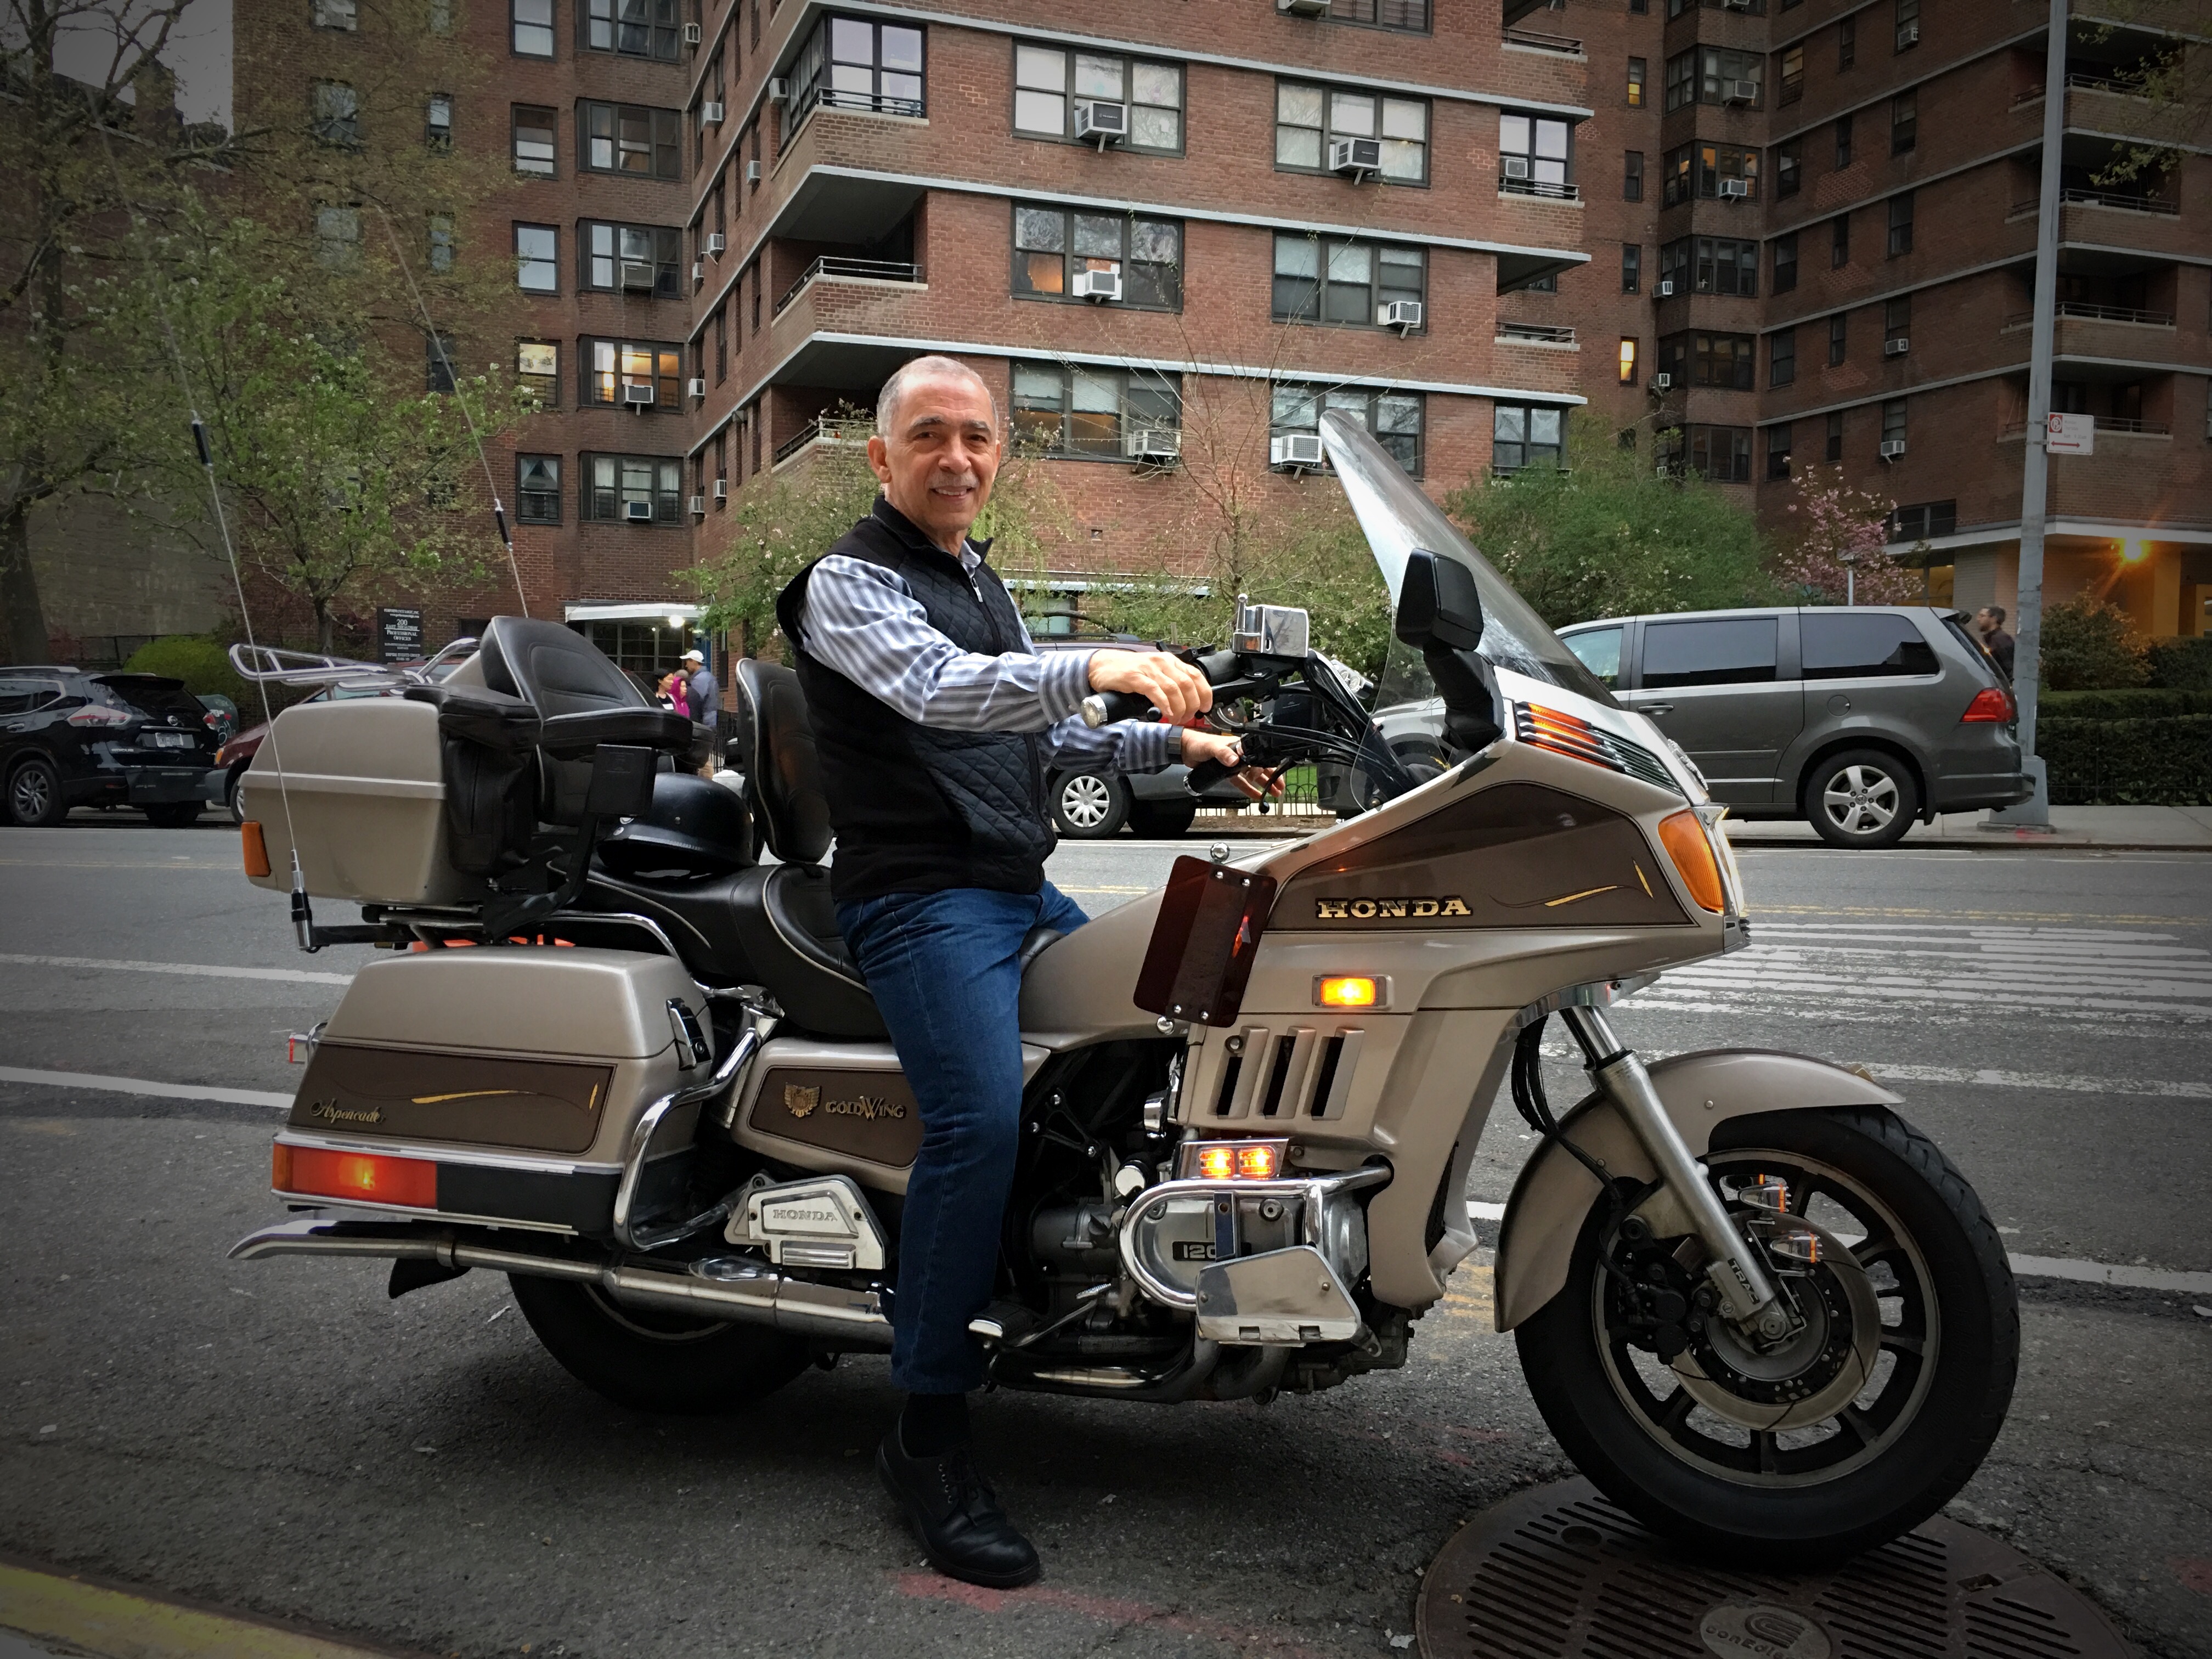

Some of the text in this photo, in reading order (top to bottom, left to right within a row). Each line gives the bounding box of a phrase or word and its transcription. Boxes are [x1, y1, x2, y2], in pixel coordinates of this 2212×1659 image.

[1317, 897, 1472, 918] HONDA
[310, 1098, 386, 1124] Aspencade
[773, 1209, 838, 1222] HONDA
